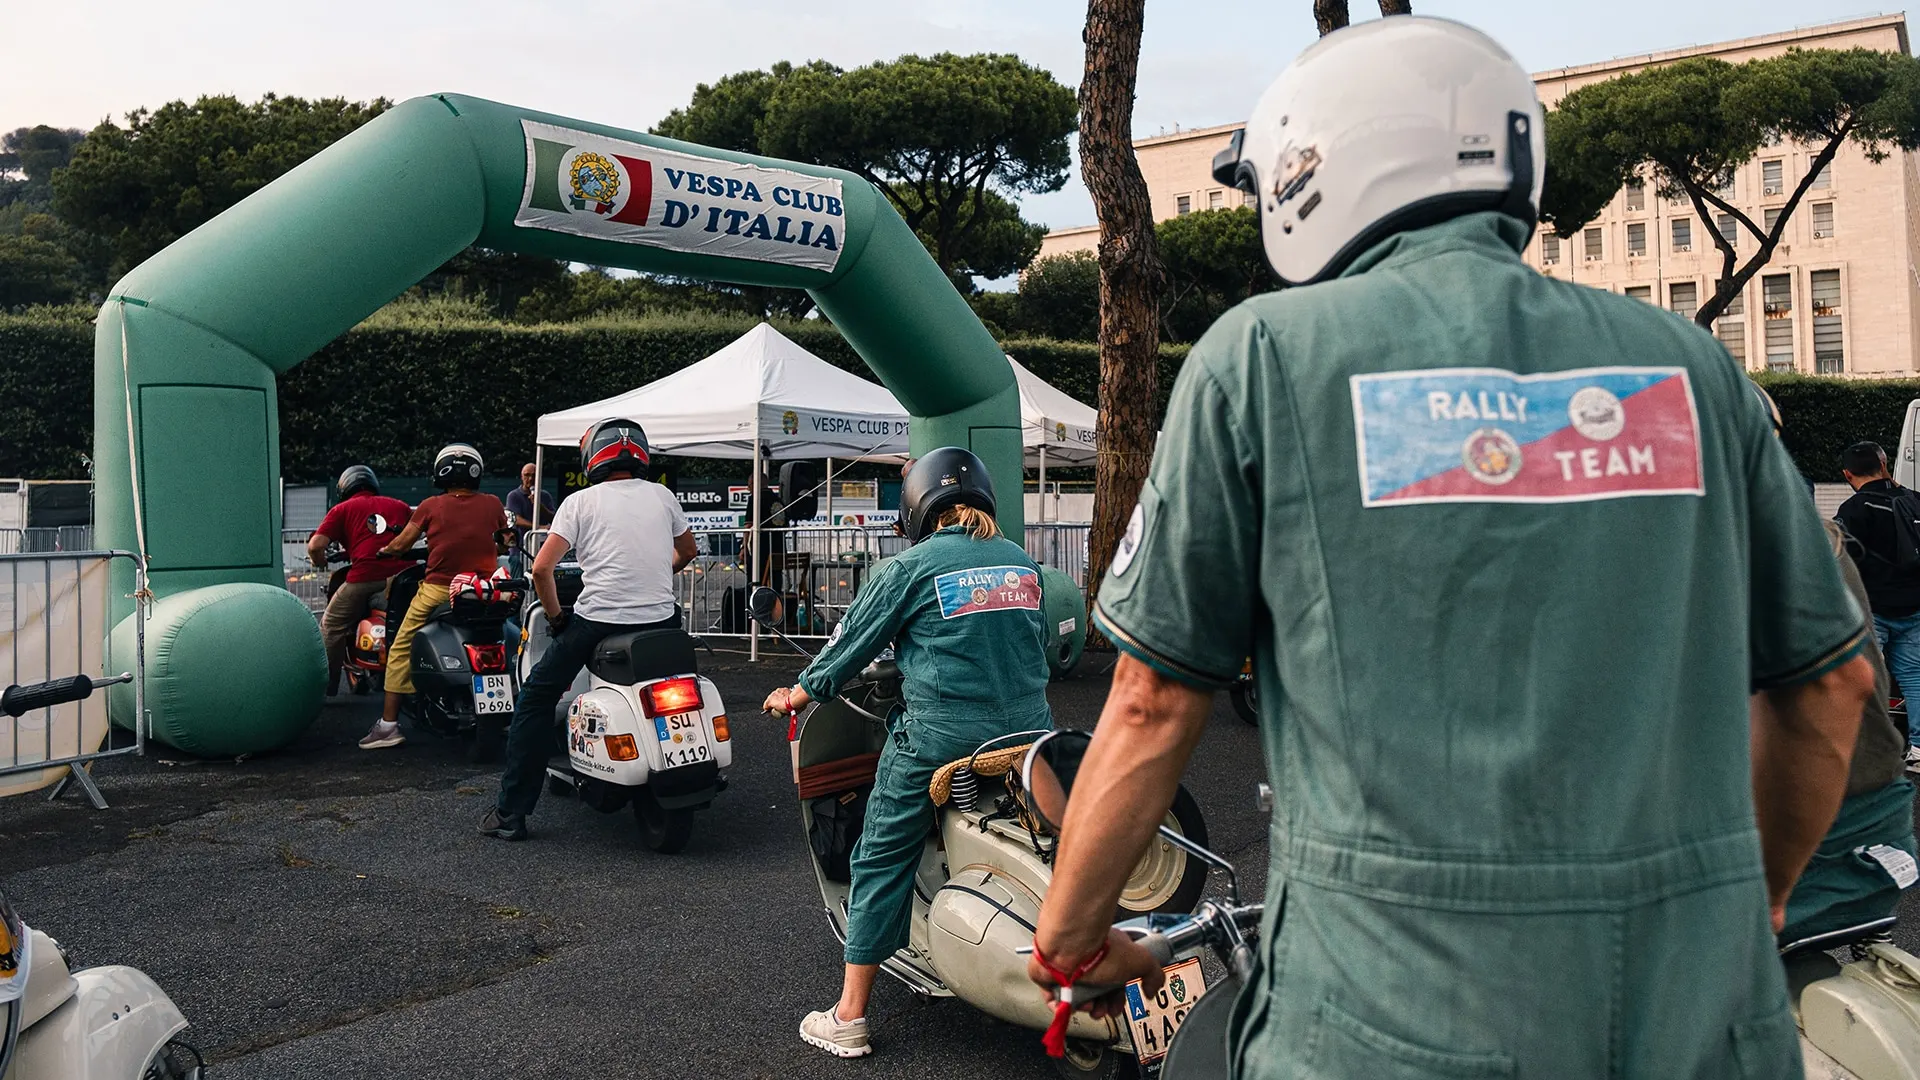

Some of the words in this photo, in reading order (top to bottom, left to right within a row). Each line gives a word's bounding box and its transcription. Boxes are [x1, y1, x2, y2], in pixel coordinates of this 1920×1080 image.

[664, 168, 762, 202] VESPA
[772, 186, 843, 216] CLUB
[660, 199, 839, 251] D'ITALIA
[811, 416, 853, 433] VESPA
[857, 420, 889, 435] CLUB
[1428, 391, 1529, 423] RALLY
[1554, 445, 1656, 481] TEAM
[959, 574, 993, 588] RALLY
[1000, 591, 1028, 602] TEAM
[487, 676, 505, 689] BN
[478, 702, 486, 712] P
[489, 701, 513, 713] 696
[670, 713, 691, 730] SU
[661, 731, 667, 739] D
[665, 752, 676, 767] K
[678, 746, 708, 766] 119
[1135, 1007, 1143, 1017] A
